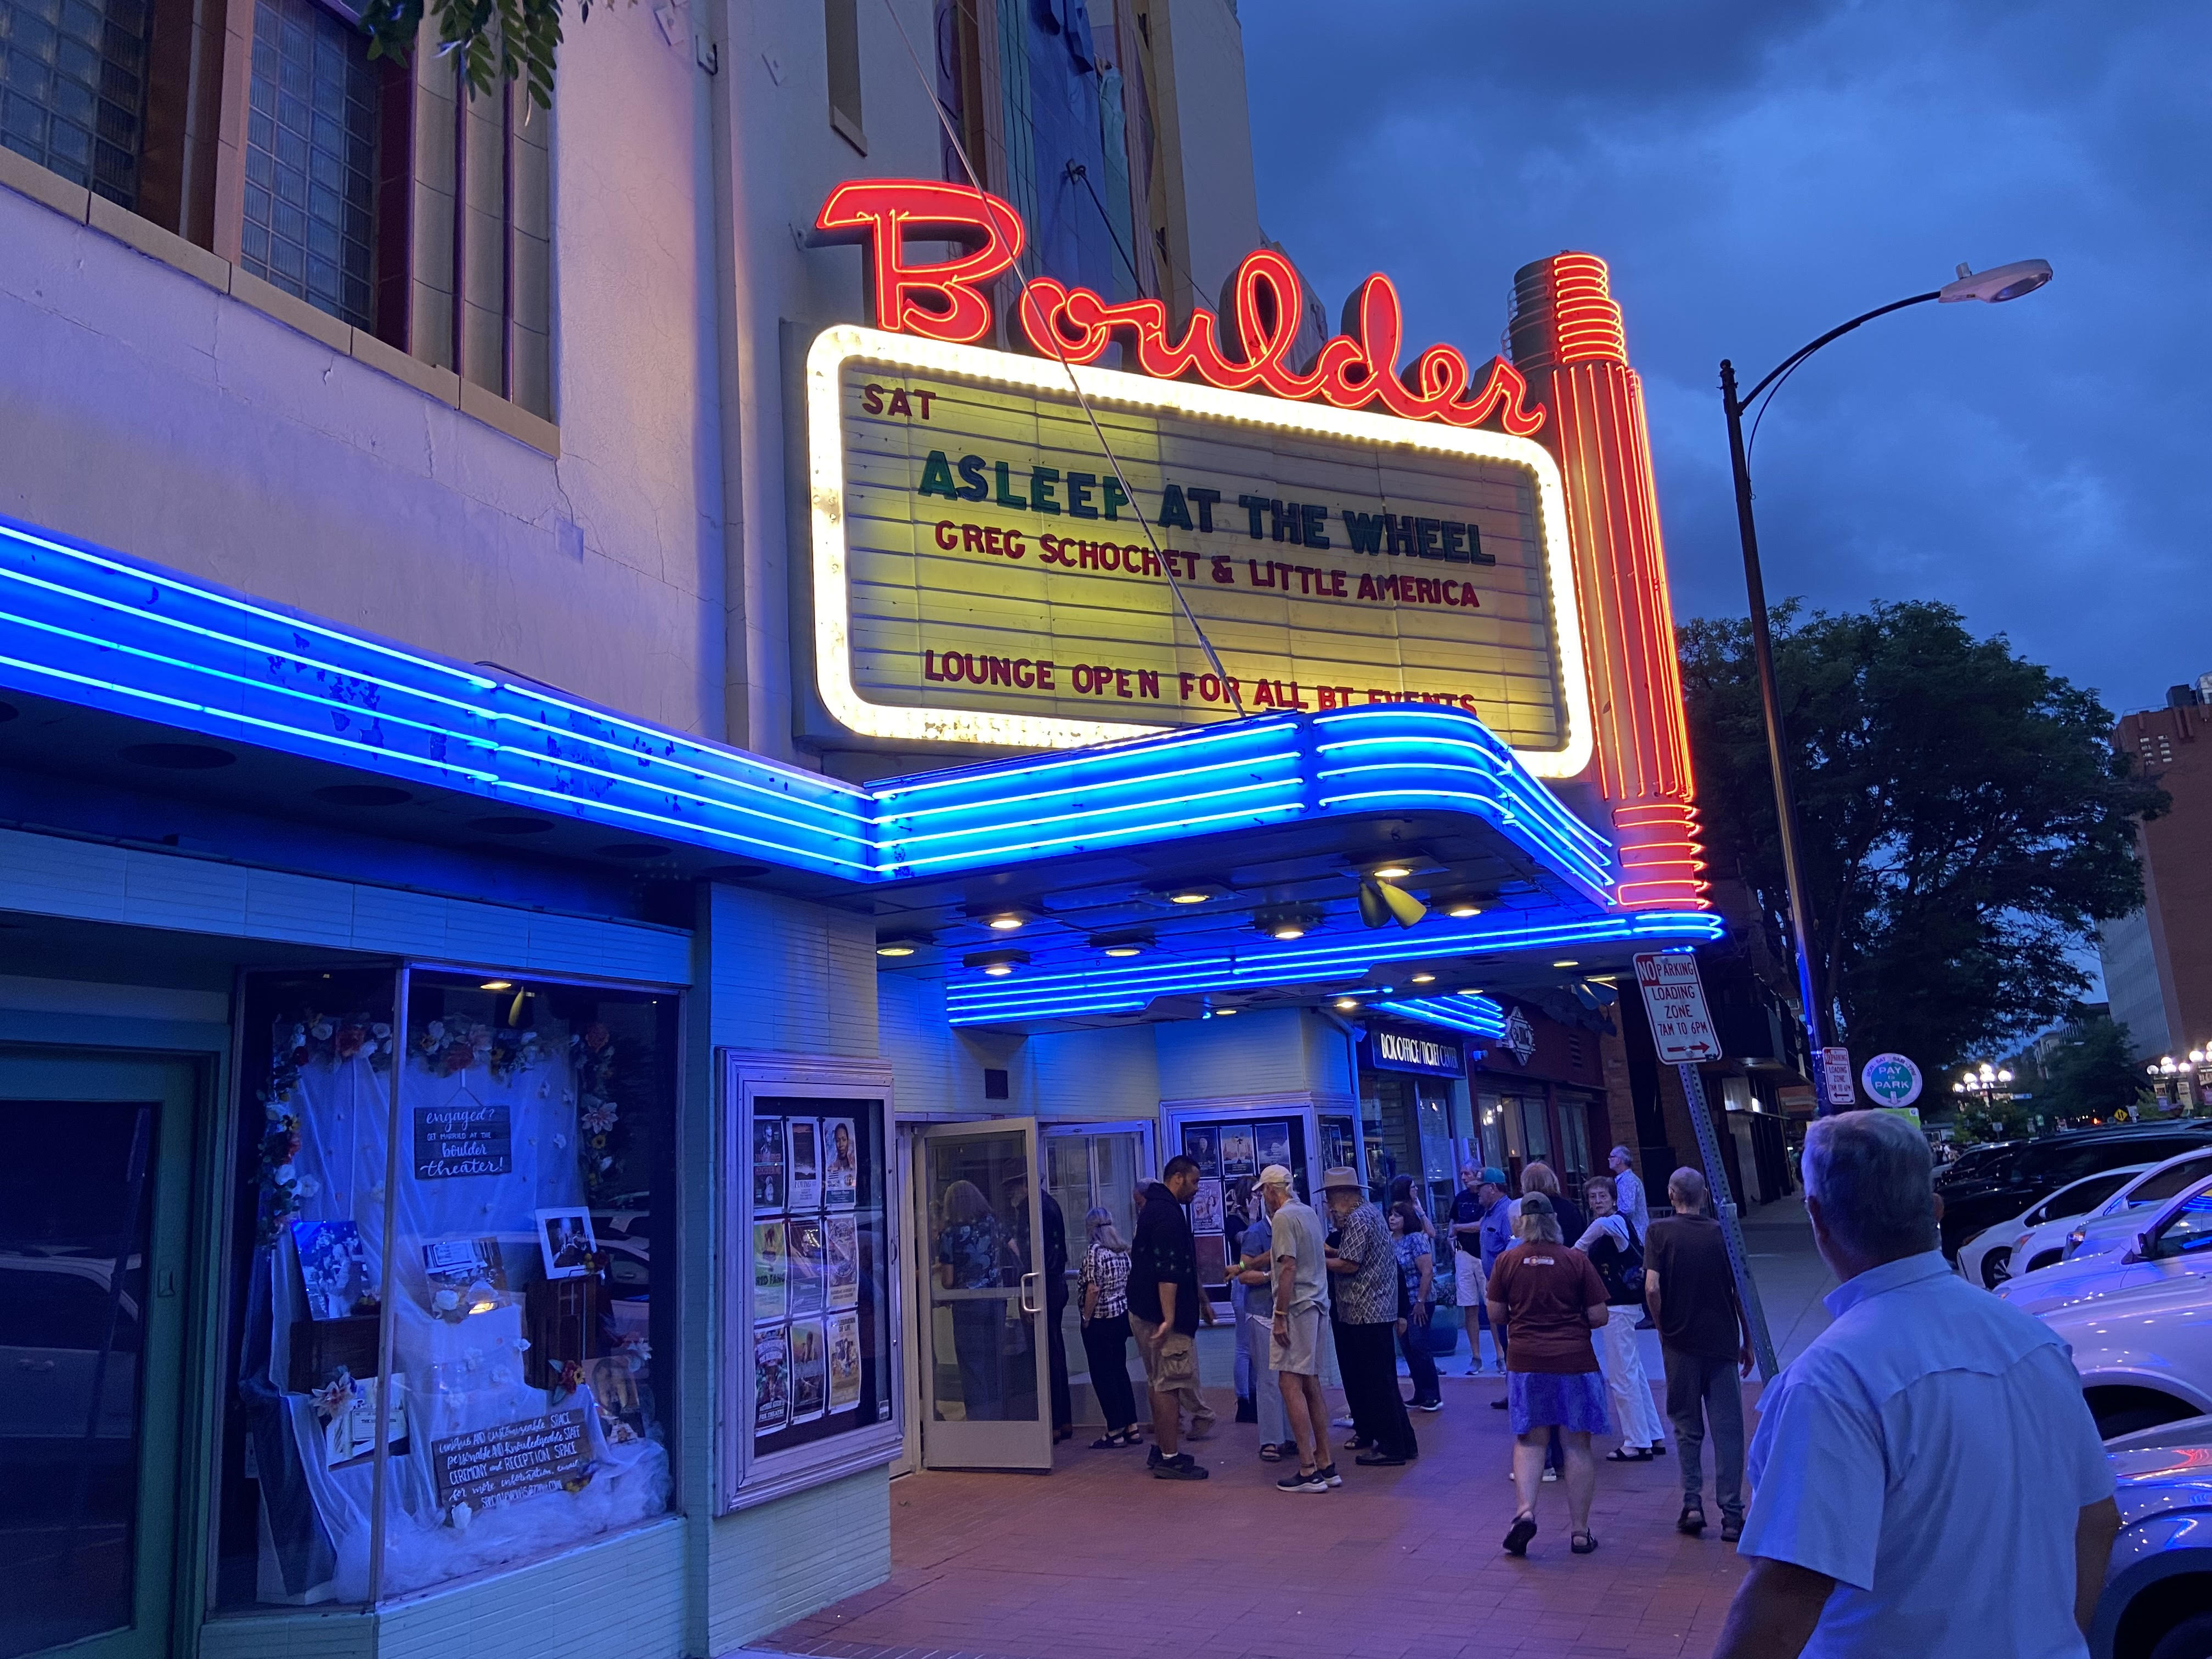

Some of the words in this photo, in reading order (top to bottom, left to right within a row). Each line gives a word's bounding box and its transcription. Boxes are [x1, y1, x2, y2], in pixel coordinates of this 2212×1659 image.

[816, 178, 1546, 437] Boulder
[862, 384, 936, 420] SAT
[918, 450, 1132, 521] ASLEEP
[1158, 484, 1221, 533] AT
[1238, 494, 1330, 549] THE
[1342, 510, 1496, 566] WHEEL
[935, 521, 1025, 560] GREG
[1038, 534, 1200, 580] SCHOCHET
[1211, 556, 1234, 584] &
[1249, 559, 1348, 597] LITTLE
[1357, 573, 1480, 608] AMERICA
[925, 650, 1055, 690] LOUNGE
[1072, 664, 1159, 699] OPEN
[1179, 672, 1242, 704] FOR
[1252, 678, 1309, 709] ALL
[1317, 685, 1354, 712] BT
[1637, 961, 1656, 981] NO
[1656, 962, 1694, 977] PARKING
[1651, 985, 1695, 1001] LOADING
[1664, 1005, 1692, 1019] ZONE
[1657, 1022, 1674, 1036] 7AM
[1677, 1022, 1687, 1035] TO
[1691, 1022, 1708, 1035] 6PM
[1380, 1033, 1397, 1060] BOX
[1440, 1045, 1459, 1069] CENTER
[1875, 1081, 1909, 1089] PARK
[442, 1141, 487, 1158] boulder
[420, 1156, 503, 1177] theater!
[473, 1431, 486, 1445] AND
[550, 1412, 571, 1428] SPACE
[492, 1442, 504, 1457] AND
[563, 1425, 580, 1440] STAFF
[450, 1463, 488, 1485] CEREMONY
[504, 1448, 551, 1471] RECEPTION
[554, 1441, 577, 1459] SPACE
[449, 1488, 467, 1502] for
[472, 1481, 495, 1494] more
